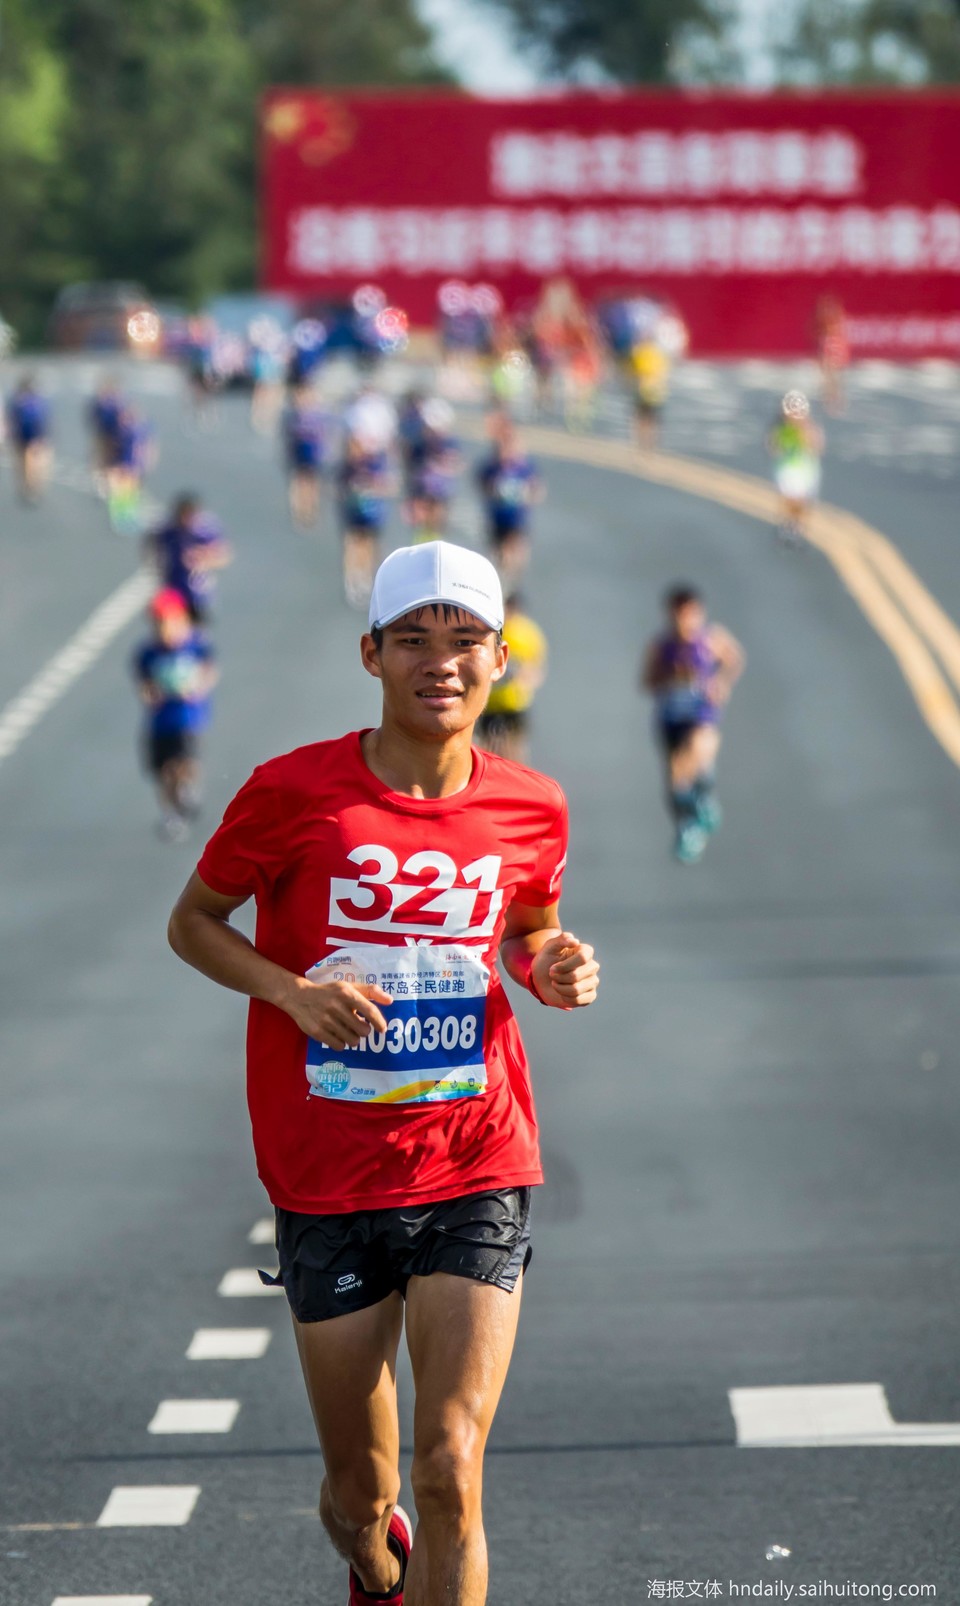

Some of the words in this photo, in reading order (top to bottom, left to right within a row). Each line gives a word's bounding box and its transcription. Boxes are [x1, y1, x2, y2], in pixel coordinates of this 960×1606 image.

[336, 843, 502, 928] 321
[381, 979, 466, 995] 环岛全民健跑
[321, 1014, 477, 1054] 030308
